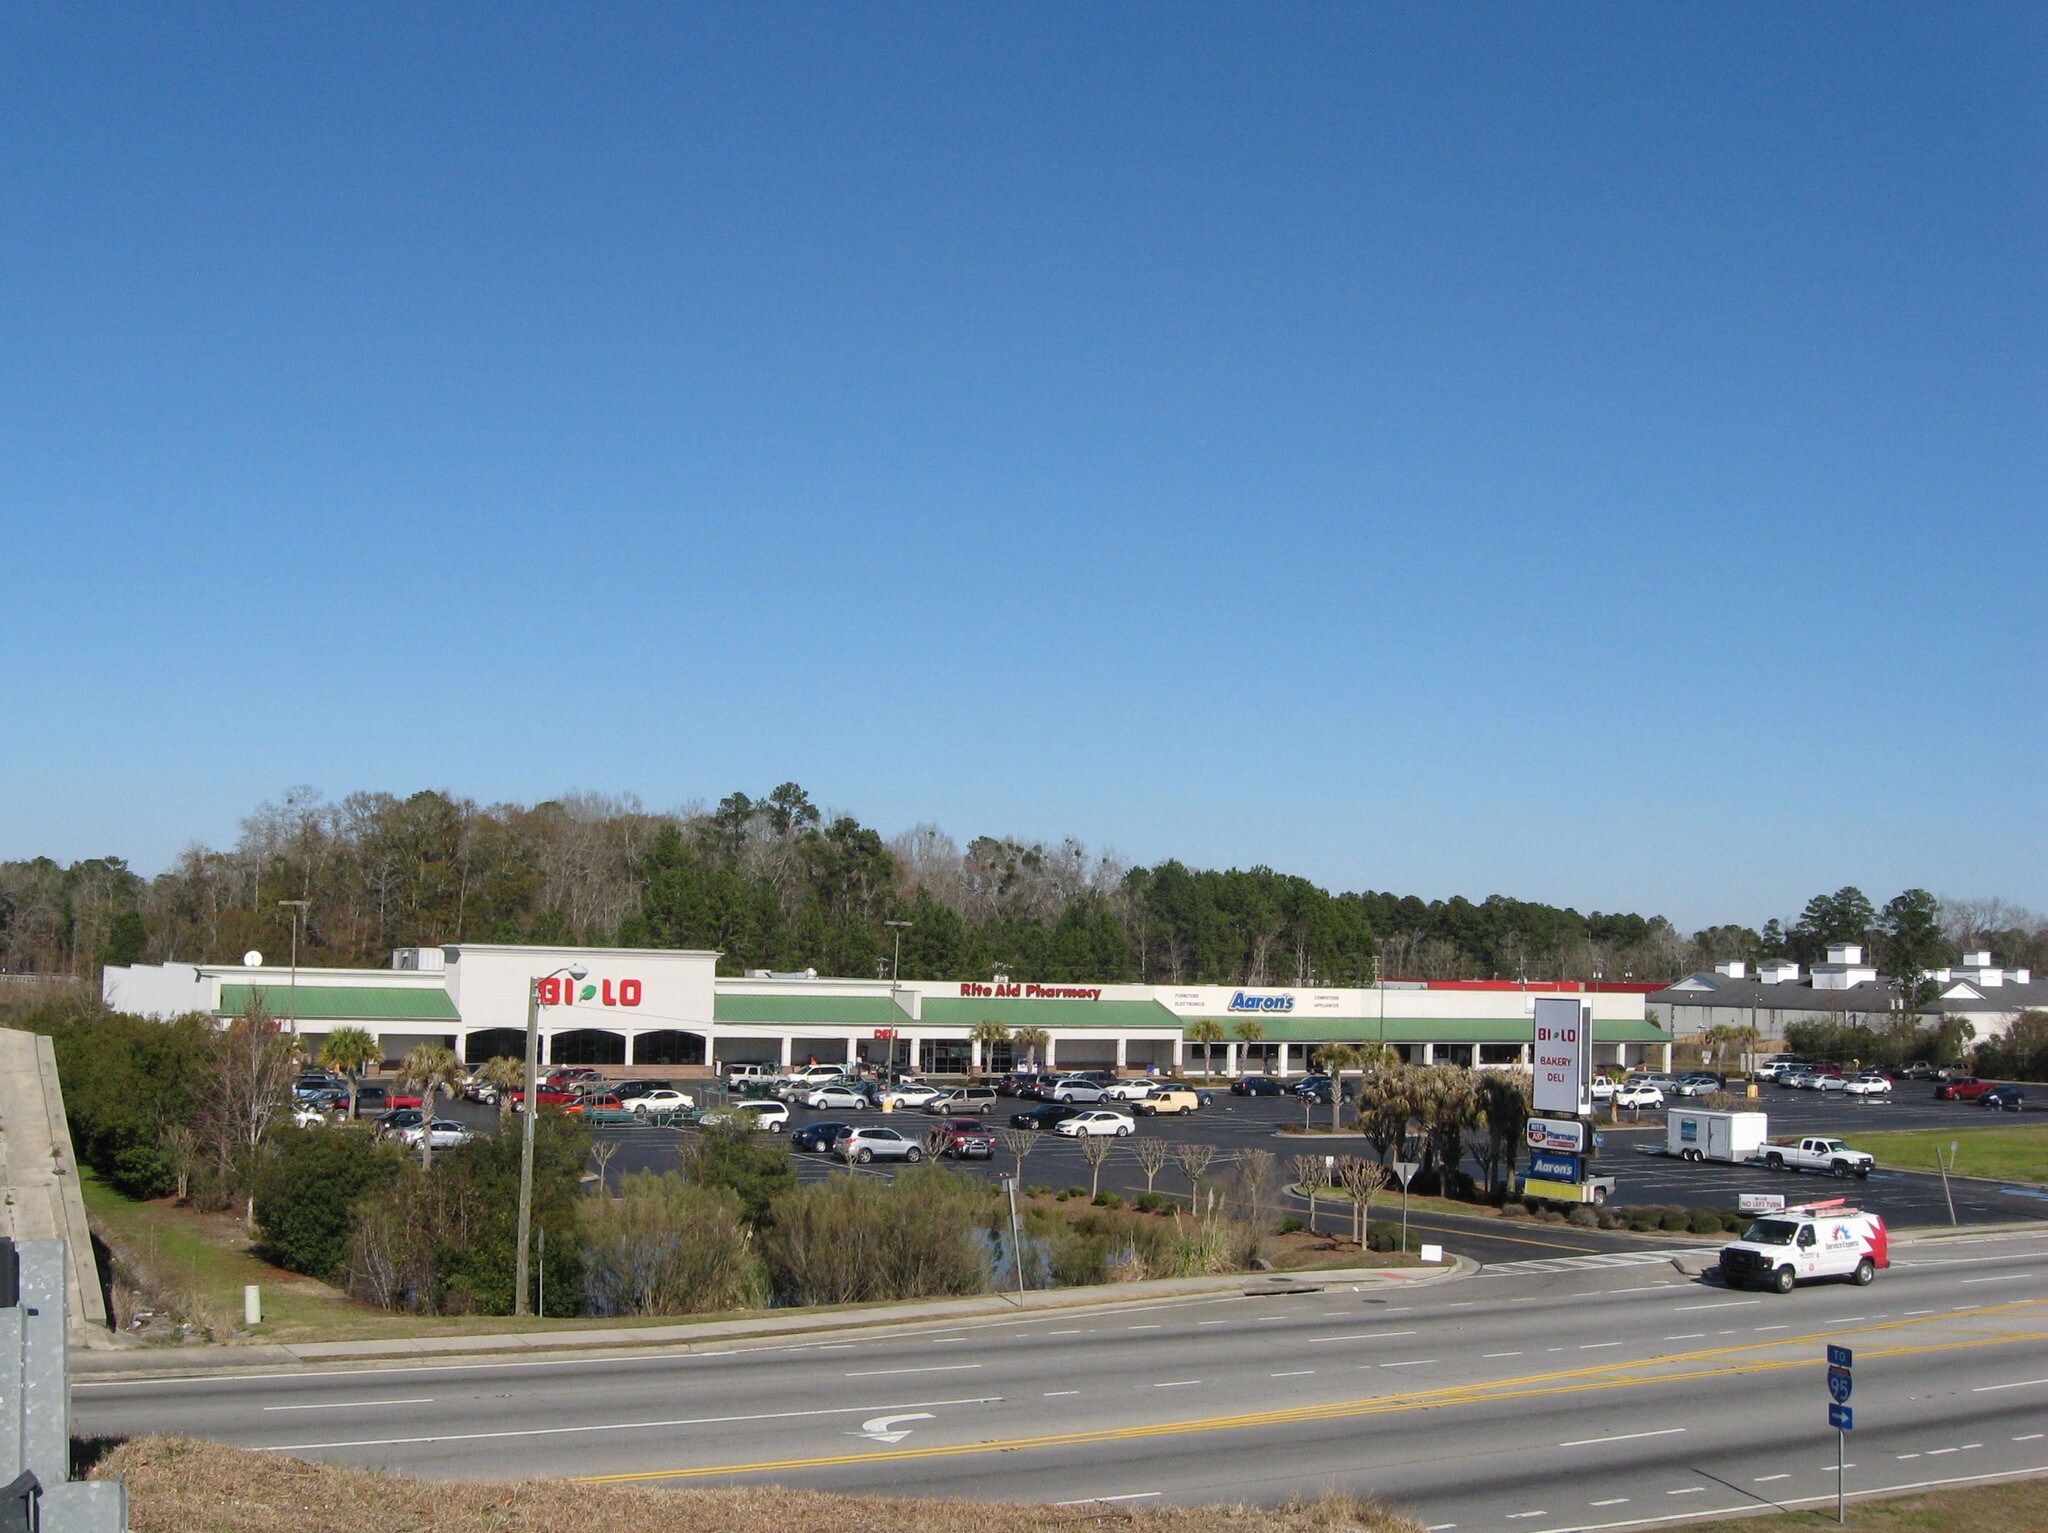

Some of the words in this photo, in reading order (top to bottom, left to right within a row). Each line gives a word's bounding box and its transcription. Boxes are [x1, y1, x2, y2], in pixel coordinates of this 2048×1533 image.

[960, 983, 992, 997] Rite
[995, 984, 1021, 997] Aid
[1025, 984, 1102, 1001] Pharmacy
[1228, 991, 1295, 1011] Aaron's
[1540, 1056, 1572, 1067] BAKERY
[1547, 1072, 1565, 1083] DELI
[1530, 1123, 1544, 1132] RITE
[1546, 1131, 1579, 1143] Pharmacy
[1534, 1159, 1573, 1175] Aaron's
[1825, 1242, 1842, 1251] Service
[1833, 1350, 1846, 1362] TO
[1830, 1377, 1848, 1400] 95
